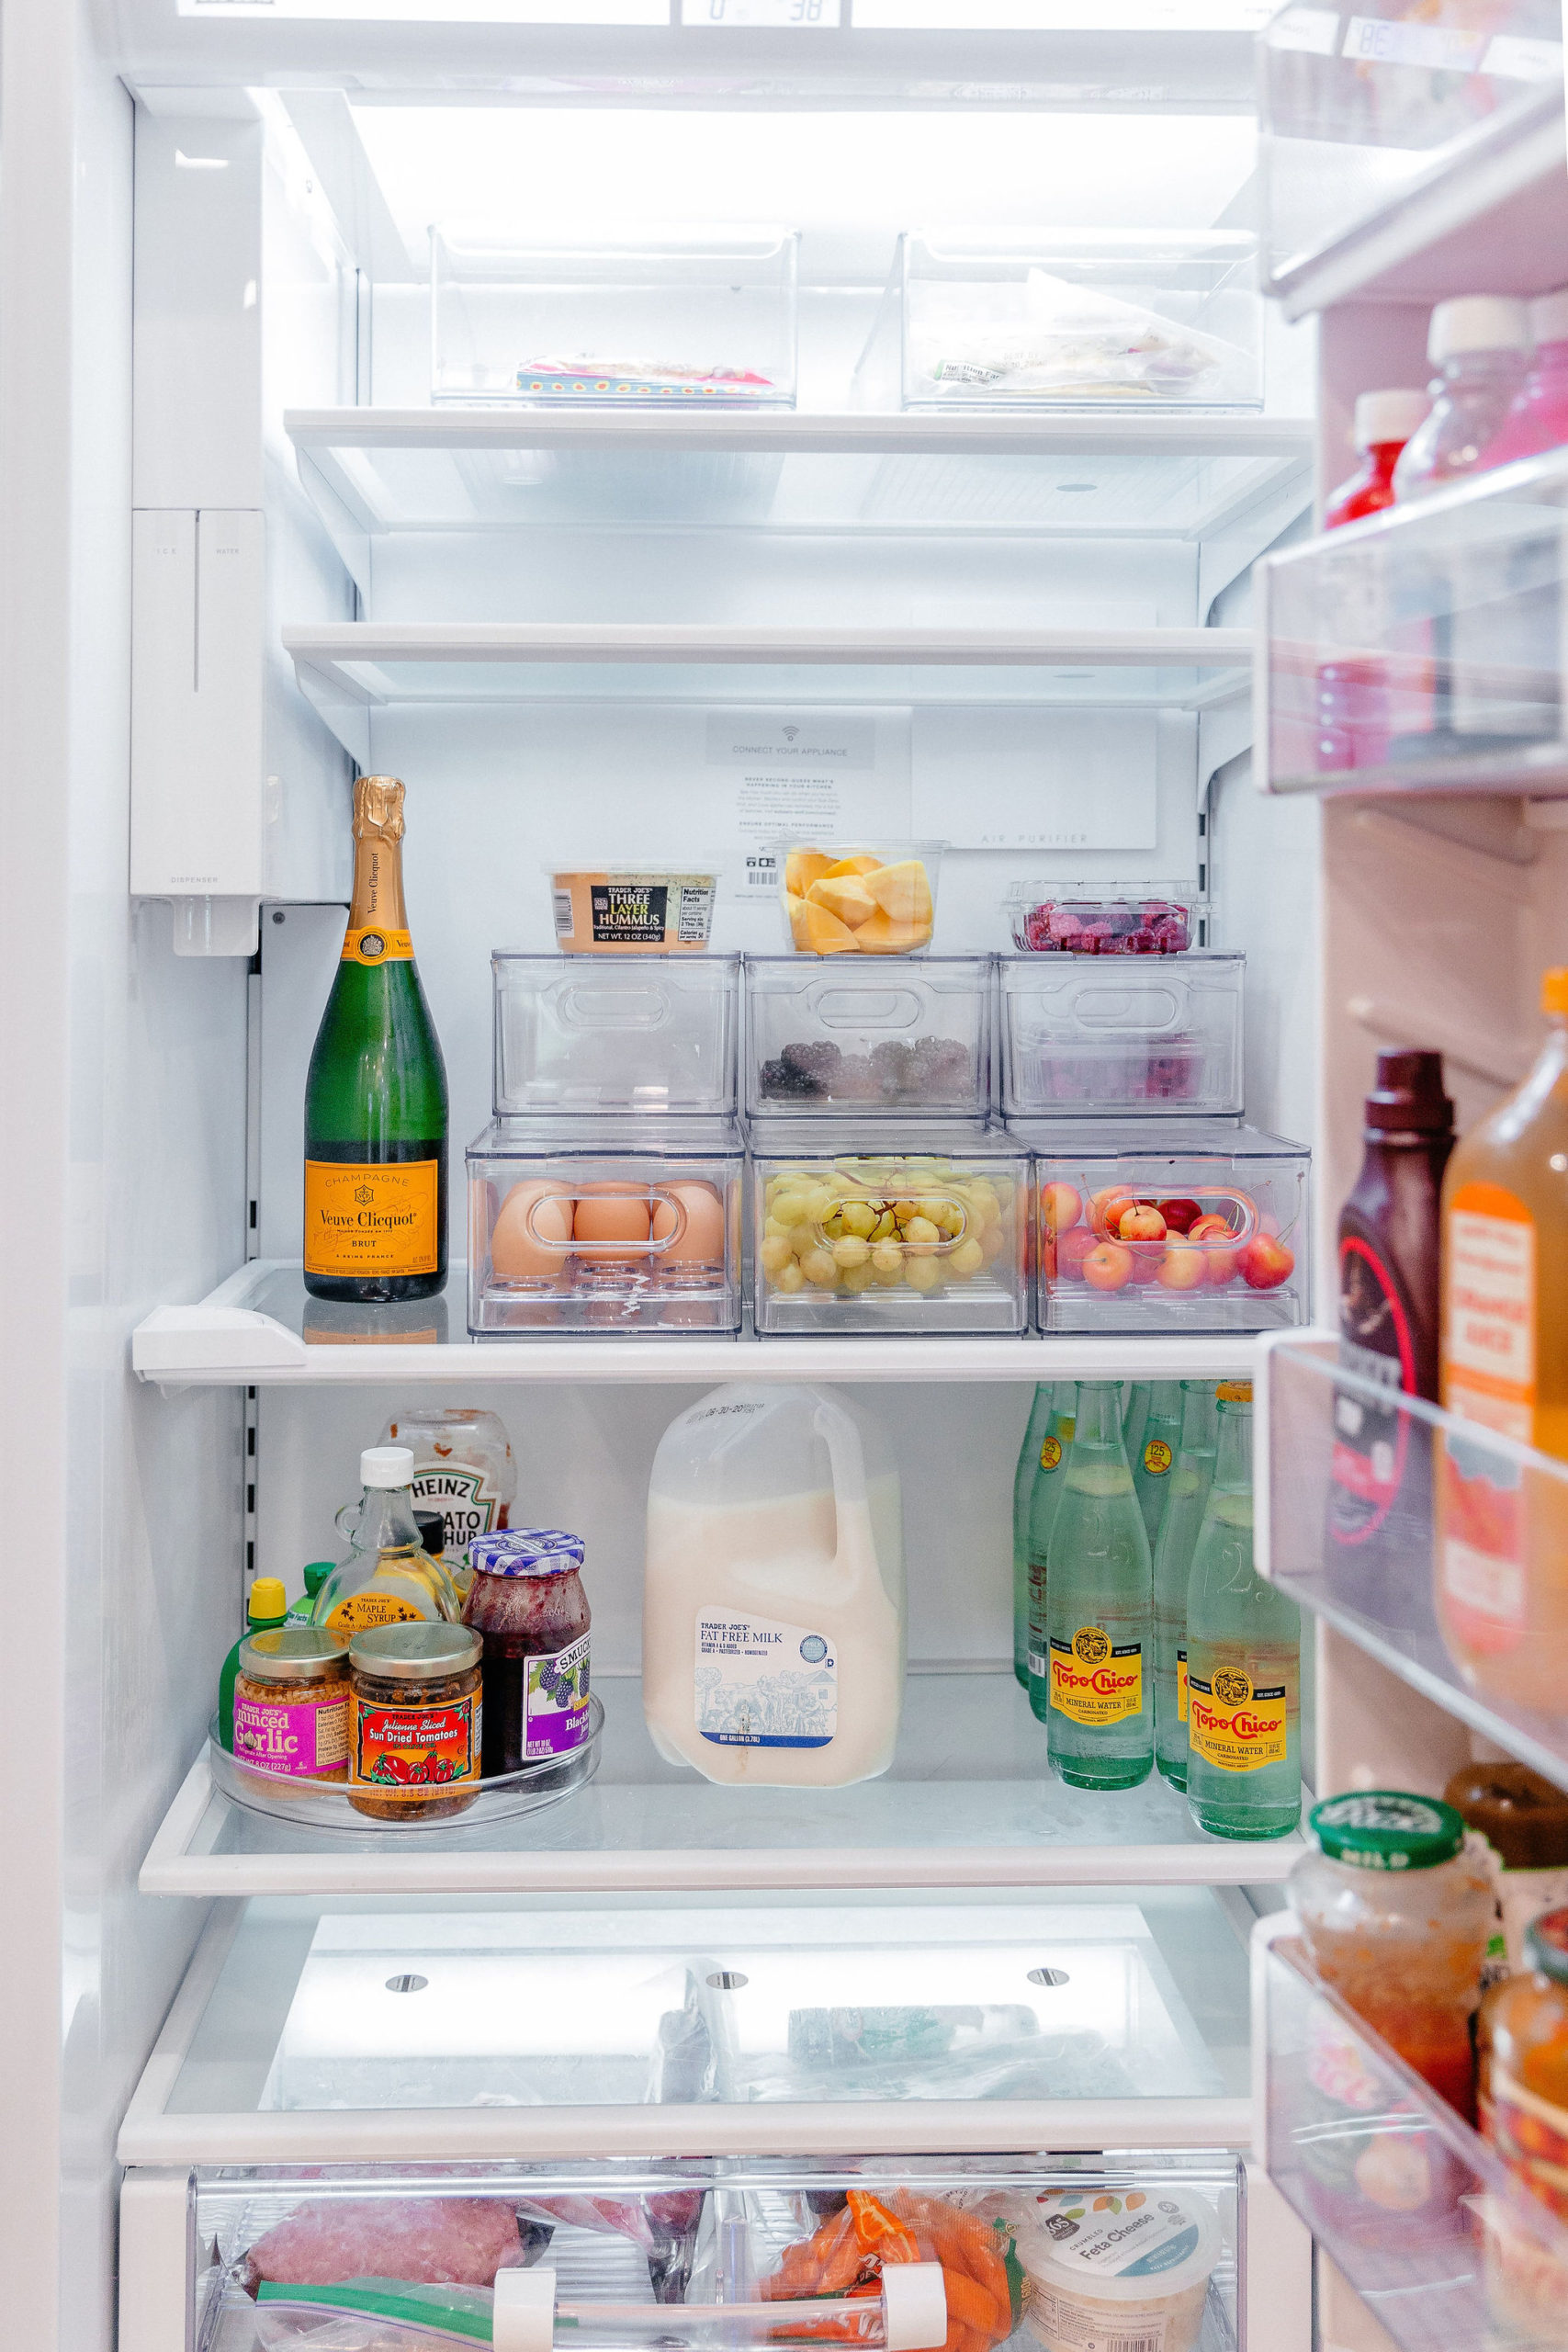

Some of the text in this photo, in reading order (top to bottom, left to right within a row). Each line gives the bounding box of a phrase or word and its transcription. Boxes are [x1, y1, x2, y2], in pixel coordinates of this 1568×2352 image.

[733, 746, 848, 756] CONNECT YOUR APPLIANCE
[981, 834, 1088, 843] AIR PURIFIER
[367, 853, 380, 914] Veuve Clicquot
[608, 894, 650, 905] THREE
[610, 905, 649, 915] LAYER
[599, 914, 660, 926] HUMMUS
[325, 1174, 410, 1188] CHAMPAGNE
[321, 1209, 354, 1227] Veuve
[1150, 1444, 1165, 1457] 125
[412, 1478, 470, 1498] HEINZ
[441, 1511, 481, 1530] ATO
[357, 1603, 387, 1614] MAPLE
[367, 1613, 397, 1623] SYRUP
[701, 1631, 783, 1643] FAT FREE MILK
[1053, 1660, 1138, 1695] Topo Chico
[242, 1703, 279, 1716] TRADER JOE'S
[1066, 1698, 1097, 1709] MINERAL
[238, 1709, 289, 1729] minced
[382, 1717, 446, 1733] Julienne Sliced
[1192, 1700, 1282, 1739] Topo Chico
[369, 1728, 458, 1743] Sun Dried Tomatoes
[1205, 1740, 1235, 1753] MINERAL
[1237, 1747, 1264, 1755] WATER
[260, 1761, 270, 1770] OZ
[271, 1762, 291, 1771] (227g)
[1069, 2229, 1103, 2251] CRUMBLED
[1080, 2242, 1112, 2260] Feta
[1107, 2212, 1156, 2243] Cheese
